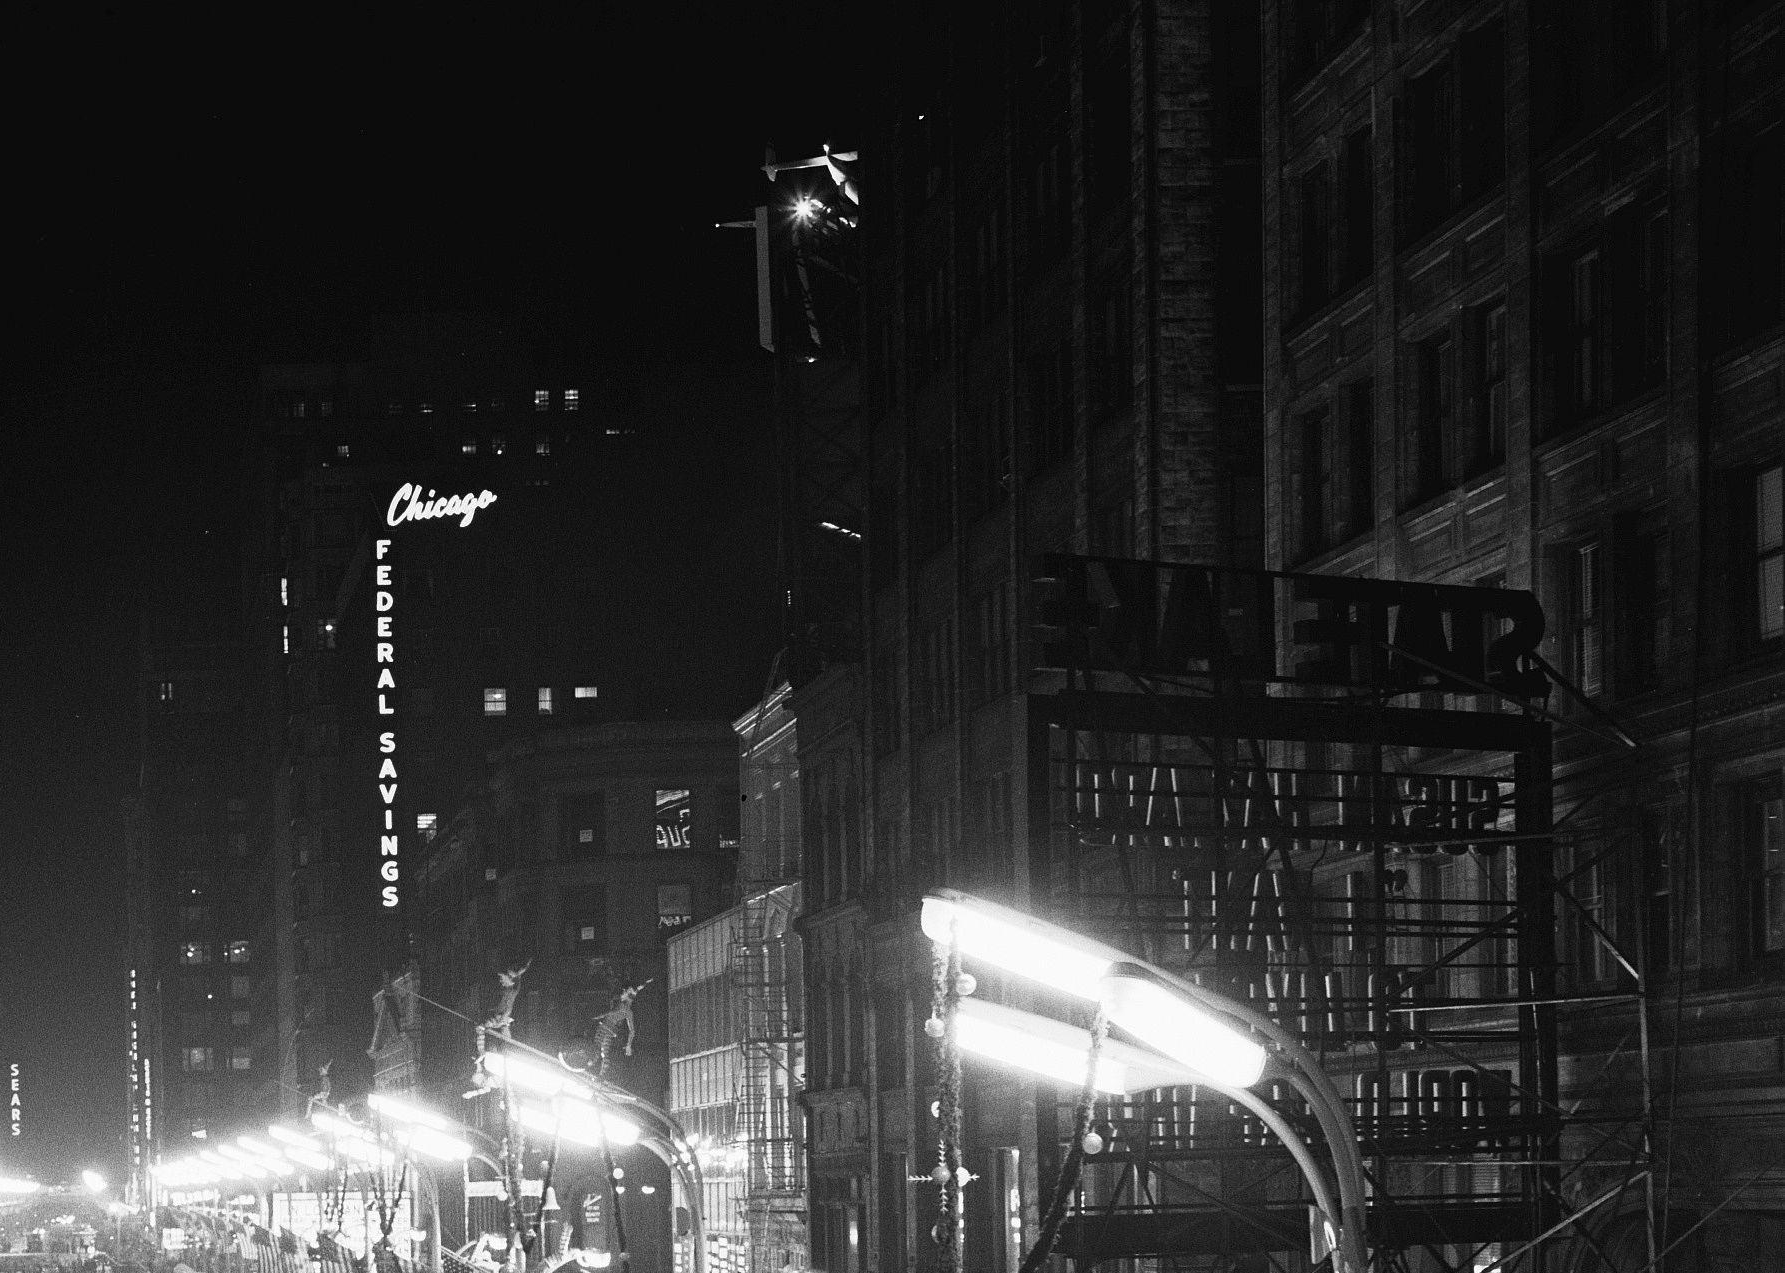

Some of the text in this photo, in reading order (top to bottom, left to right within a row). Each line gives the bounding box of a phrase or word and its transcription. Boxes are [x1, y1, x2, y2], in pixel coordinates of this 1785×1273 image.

[387, 483, 497, 527] Chicago
[376, 540, 395, 715] FEDERAL
[378, 732, 399, 907] SAVINGS
[10, 1063, 21, 1136] SEARS
